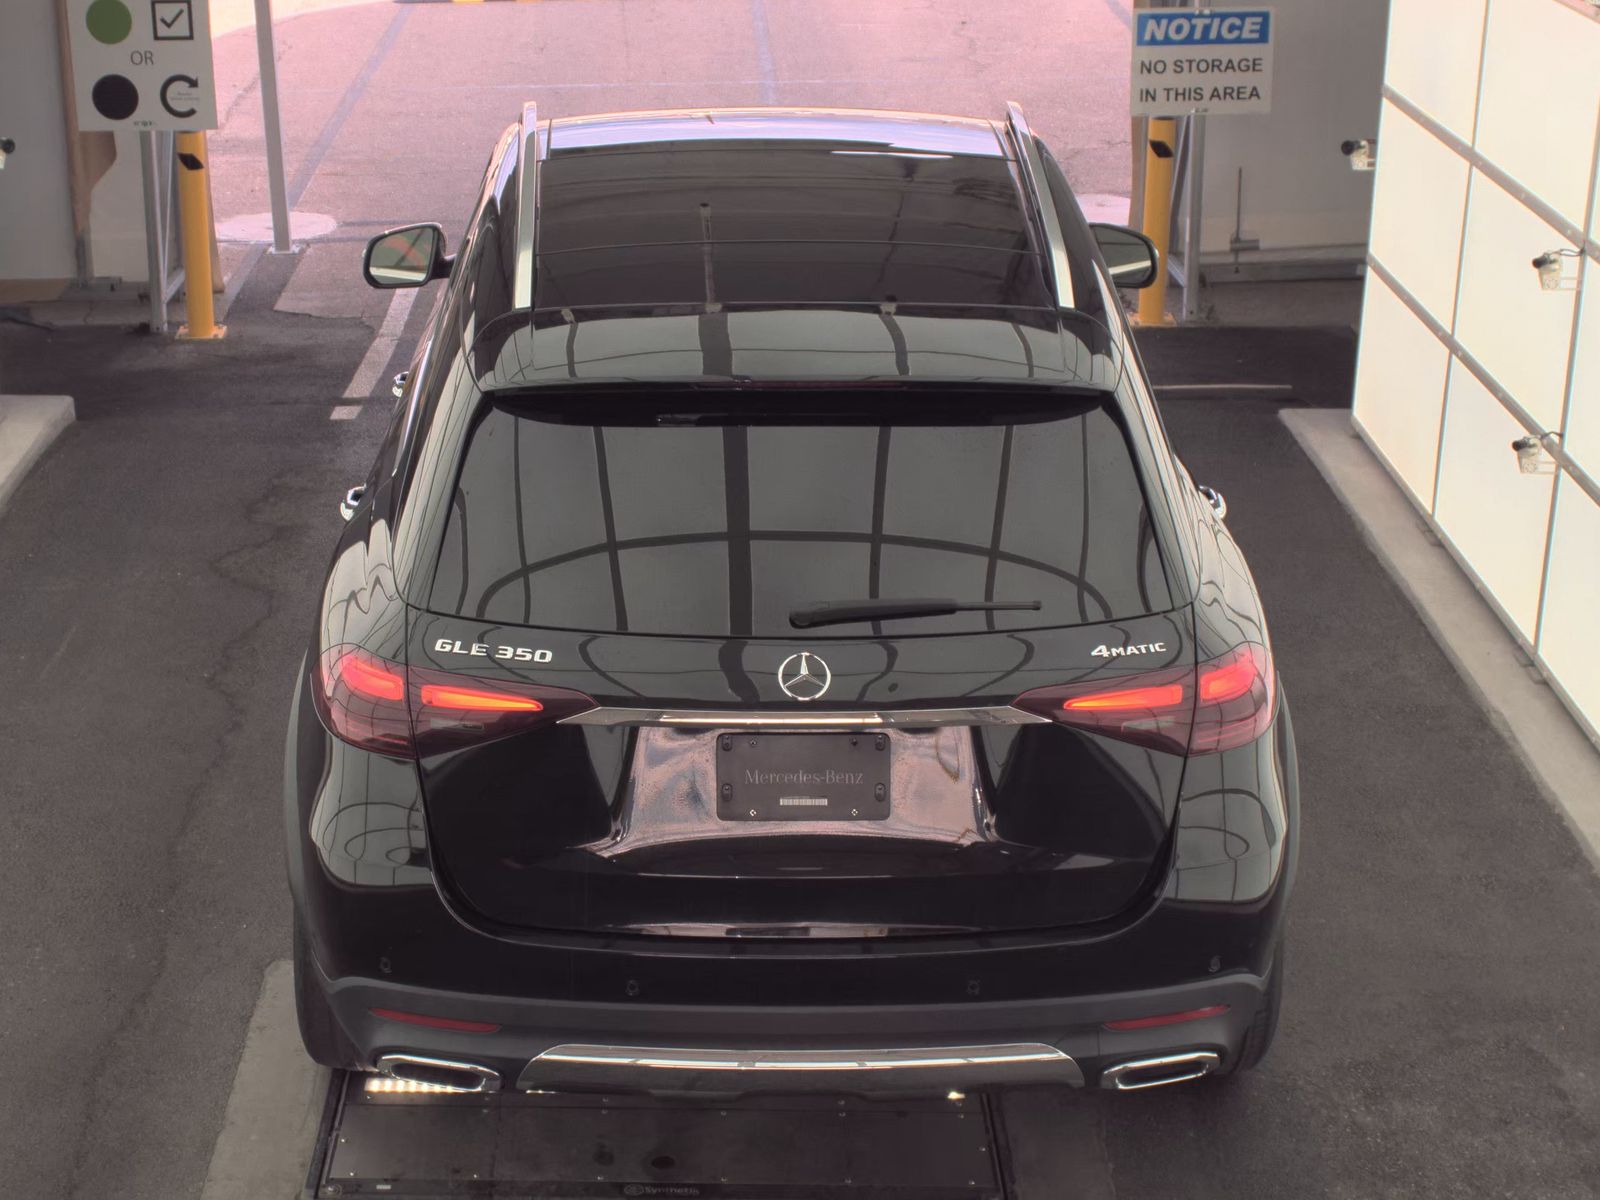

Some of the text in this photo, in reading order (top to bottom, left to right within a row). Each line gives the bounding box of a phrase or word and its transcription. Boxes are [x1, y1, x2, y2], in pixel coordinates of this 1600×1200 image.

[1144, 17, 1263, 41] NOTICE
[130, 50, 154, 66] OR
[1140, 58, 1263, 74] NO STORAGE
[1140, 86, 1261, 102] IN THIS AREA
[434, 638, 553, 663] GLE 350
[1090, 642, 1167, 658] 4MATIC
[744, 769, 864, 785] Mercedes-Benz
